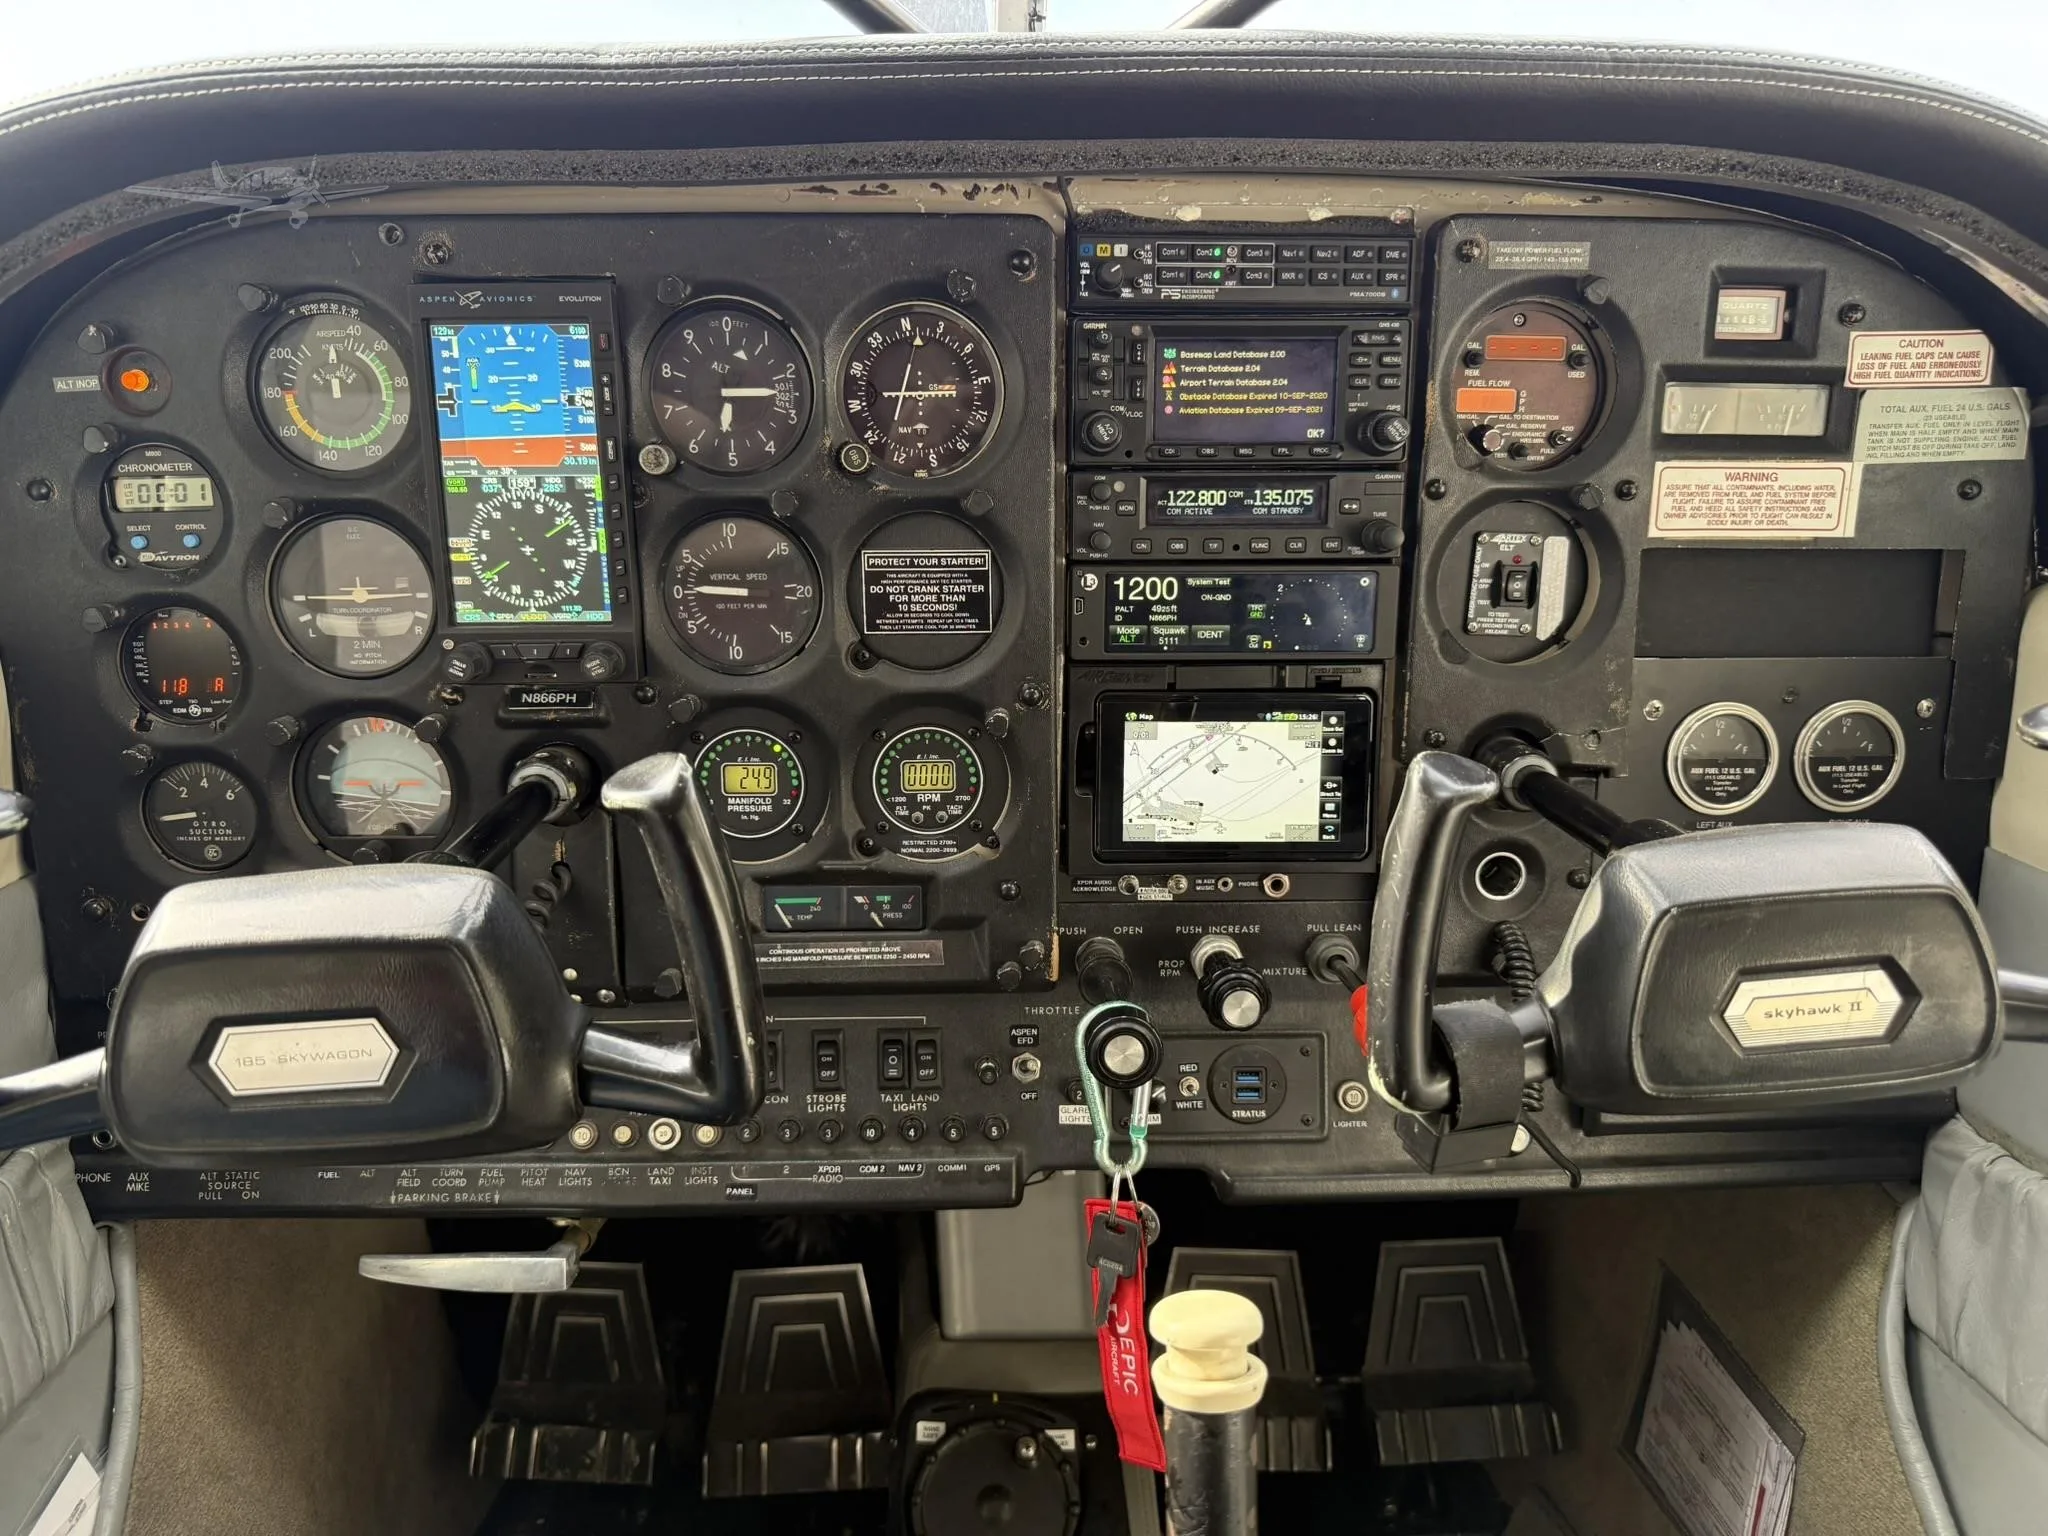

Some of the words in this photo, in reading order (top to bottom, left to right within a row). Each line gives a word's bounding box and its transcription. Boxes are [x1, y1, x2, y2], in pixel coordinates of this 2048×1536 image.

[1162, 248, 1178, 256] Com1
[1196, 248, 1212, 256] Com2
[346, 326, 361, 336] 40
[374, 342, 388, 351] 60
[1900, 339, 1944, 348] CAUTION
[270, 349, 291, 358] 200
[1861, 352, 1891, 360] LEAKING
[1956, 351, 1980, 359] CAUSE
[712, 361, 730, 373] ALT
[1857, 362, 1875, 370] LOSS
[1890, 362, 1907, 370] FUEL
[1929, 361, 1981, 369] ERRONEOUSLY
[1894, 371, 1931, 379] QUANTITY
[1934, 370, 1983, 378] INDICATIONS.
[56, 380, 73, 389] ALT
[76, 379, 97, 389] INOP
[395, 378, 408, 387] 80
[264, 388, 281, 398] 180
[1246, 406, 1274, 414] Expired
[392, 415, 408, 424] 100
[280, 427, 297, 436] 160
[1307, 429, 1324, 438] OK?
[366, 446, 382, 455] 120
[320, 452, 337, 460] 140
[118, 464, 192, 472] CHRONOMETER
[1725, 472, 1778, 482] WARNING
[1168, 491, 1226, 506] 122.800
[1254, 490, 1314, 506] 135.075
[869, 558, 910, 566] PROTECT
[1114, 577, 1178, 600] 1200
[940, 594, 965, 602] THAN
[1154, 627, 1186, 636] Squawk
[522, 693, 576, 703] N866PH
[908, 764, 950, 786] 0000
[918, 794, 941, 802] RPM
[1209, 925, 1260, 933] INCREASE
[1307, 924, 1330, 932] PULL
[1334, 923, 1361, 932] LEAN
[1262, 968, 1307, 976] MIXTURE
[1025, 1006, 1080, 1015] THROTTLE
[1764, 1006, 1841, 1019] skyhawk
[278, 1048, 372, 1065] SKYWAGON
[1180, 1064, 1198, 1072] RED
[807, 1094, 847, 1102] STROBE
[881, 1094, 904, 1102] TAXI
[808, 1104, 845, 1112] LIGHTS
[893, 1103, 927, 1111] LIGHTS
[1176, 1101, 1203, 1109] WHITE
[1232, 1110, 1266, 1118] STRATUS
[819, 1165, 841, 1173] XPDR
[128, 1173, 149, 1181] AUX
[126, 1183, 150, 1192] MIKE
[208, 1182, 250, 1190] SOURCE
[398, 1193, 449, 1202] PARKING
[455, 1193, 491, 1202] BRAKE
[1109, 1336, 1120, 1384] AIRCRAFT
[1120, 1337, 1138, 1395] EPIC
